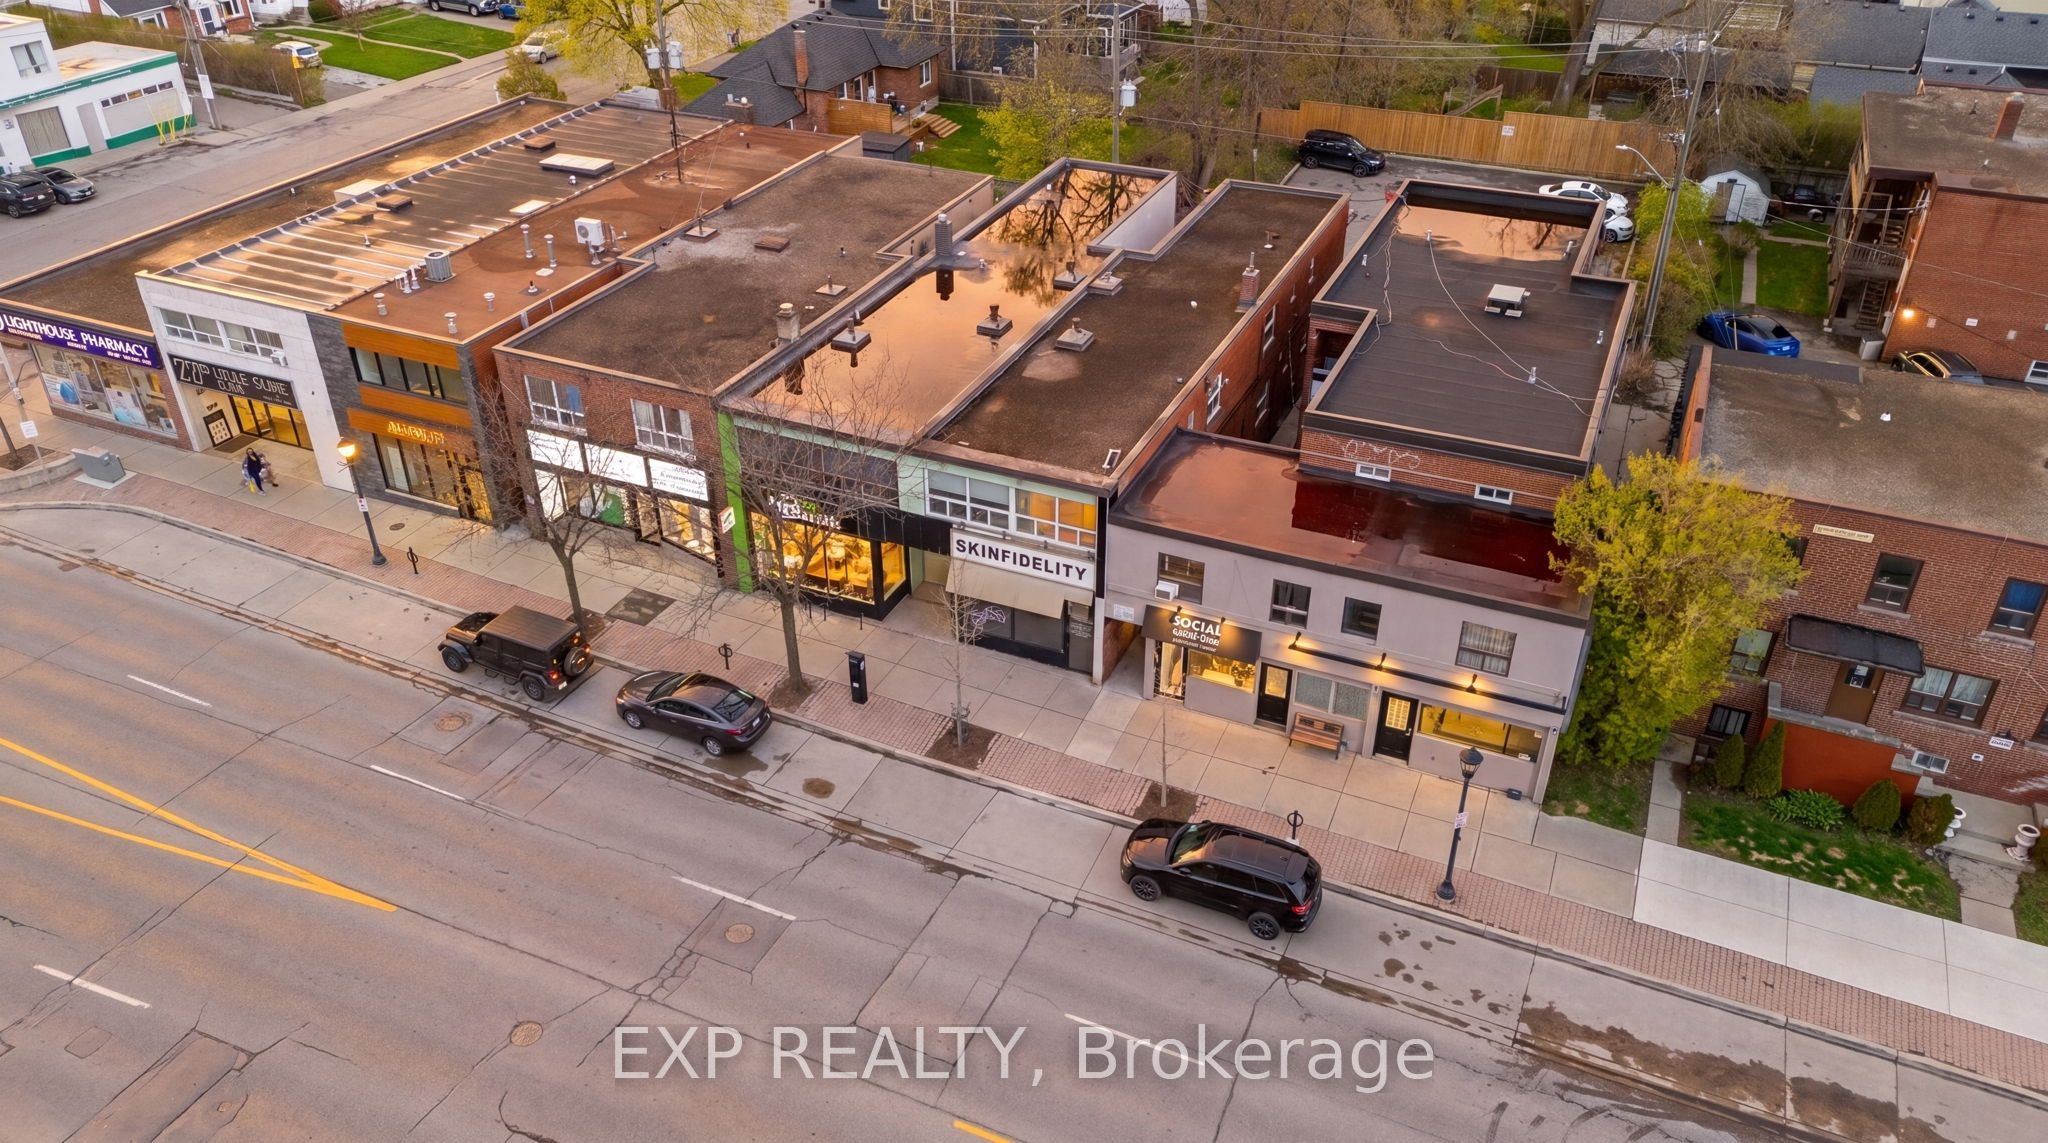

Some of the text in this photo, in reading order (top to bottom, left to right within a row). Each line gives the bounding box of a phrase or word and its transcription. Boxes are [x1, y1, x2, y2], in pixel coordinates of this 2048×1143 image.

[3, 314, 78, 342] LIGHTHOUSE
[80, 332, 149, 358] PHARMACY
[956, 539, 1087, 581] SKINFIDELITY
[1172, 615, 1222, 637] SOCIAL
